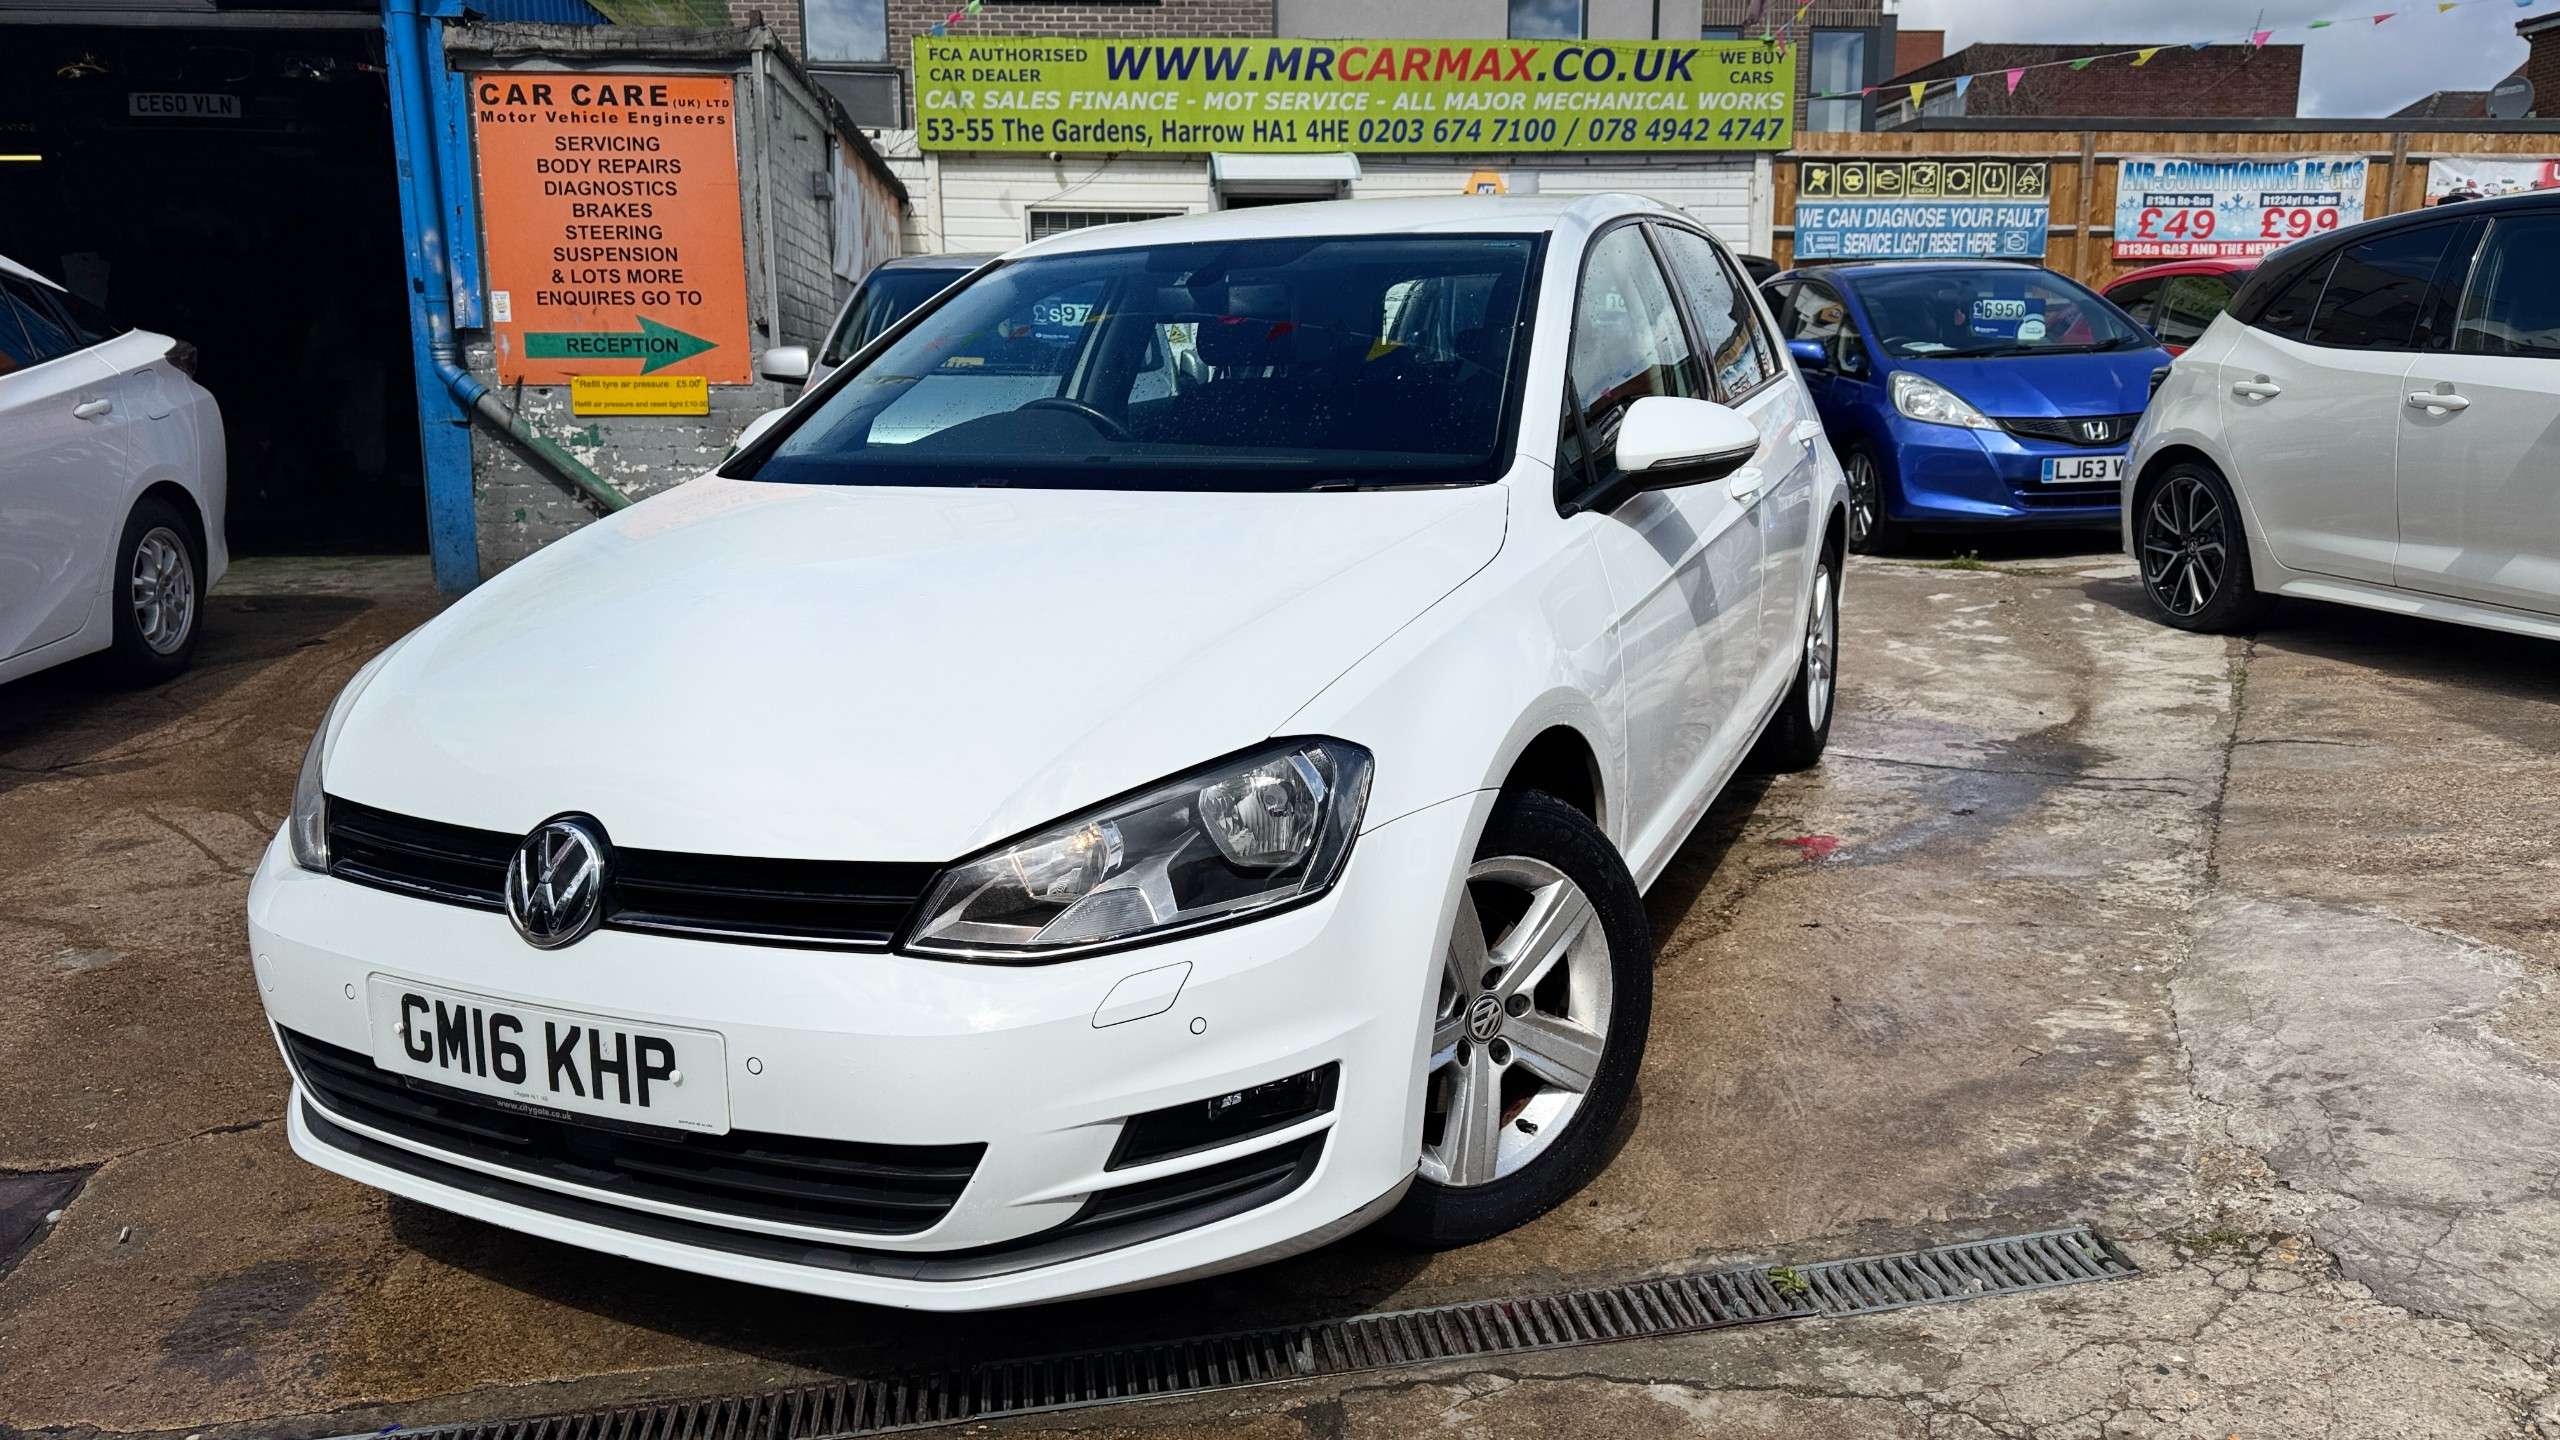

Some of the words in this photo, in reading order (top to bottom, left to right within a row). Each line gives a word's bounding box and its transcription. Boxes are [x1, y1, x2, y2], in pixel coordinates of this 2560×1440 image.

[928, 48, 963, 62] FCA
[969, 48, 1088, 63] AUTHORISED
[1106, 45, 1698, 82] WWW.MRCARMAX.CO.UK
[1720, 51, 1746, 65] WE
[1752, 51, 1786, 65] BUY
[929, 68, 966, 82] CAR
[972, 68, 1041, 82] DEALER
[1729, 71, 1774, 84] CARS
[479, 83, 553, 106] CAR
[571, 84, 669, 107] CARE
[673, 99, 701, 109] (UK)
[706, 99, 730, 108] LTD
[924, 90, 976, 111] CAR
[982, 90, 1060, 111] SALES
[1068, 90, 1179, 111] FINANCE
[1203, 91, 1255, 111] MOT
[1263, 91, 1369, 111] SERVICE
[1392, 91, 1437, 111] ALL
[1443, 91, 1526, 111] MAJOR
[1535, 91, 1687, 111] MECHANICAL
[1697, 91, 1785, 111] WORKS
[136, 94, 186, 113] CE60
[192, 95, 232, 115] VLN
[480, 111, 537, 123] Motor
[546, 111, 618, 124] Vehicle
[628, 112, 726, 126] Engineers
[927, 117, 995, 142] 53-55
[1002, 117, 1044, 142] The
[1052, 117, 1153, 148] Gardens,
[1162, 118, 1244, 142] Harrow
[1253, 118, 1298, 142] HA1
[1306, 118, 1349, 142] 4HE
[1358, 117, 1424, 143] 0203
[1433, 117, 1482, 143] 674
[1492, 117, 1557, 143] 7100
[1563, 117, 1580, 146] /
[1588, 117, 1637, 142] 078
[1645, 117, 1710, 142] 4942
[1718, 117, 1784, 142] 4747
[555, 135, 660, 152] SERVICING
[536, 158, 591, 174] BODY
[598, 158, 682, 174] REPAIRS
[2122, 161, 2299, 192] AIR-CONDITIONING
[2303, 160, 2365, 191] RE-GAS
[544, 181, 678, 197] DIAGNOSTICS
[2178, 195, 2211, 207] Re-Gas
[2302, 194, 2338, 206] Re-Gas
[572, 203, 653, 218] BRAKES
[1799, 208, 1823, 228] WE
[1827, 208, 1861, 228] CAN
[1865, 208, 1945, 228] DIAGNOSE
[1950, 208, 1996, 228] YOUR
[1996, 208, 2043, 228] FAULT
[2136, 207, 2216, 240] £49
[2260, 207, 2339, 239] £99
[565, 225, 663, 241] STEERING
[1843, 232, 1893, 253] SERVICE
[1893, 232, 1930, 253] LIGHT
[1931, 232, 1966, 253] RESET
[1967, 232, 1998, 253] HERE
[2162, 243, 2189, 256] GAS
[2190, 243, 2218, 255] AND
[2218, 243, 2243, 255] THE
[2245, 243, 2275, 255] NEW
[553, 247, 678, 262] SUSPENSION
[552, 269, 565, 284] &
[571, 269, 621, 284] LOTS
[627, 269, 684, 284] MORE
[536, 291, 636, 307] ENQUIRES
[641, 291, 671, 306] GO
[676, 291, 703, 306] TO
[1973, 301, 2025, 319] £6950
[566, 337, 679, 354] RECEPTION
[602, 380, 619, 391] tyre
[621, 380, 632, 389] air
[633, 381, 669, 391] pressure
[2056, 460, 2107, 479] LJ63
[400, 992, 527, 1084] GM16
[544, 1021, 676, 1107] KHP
